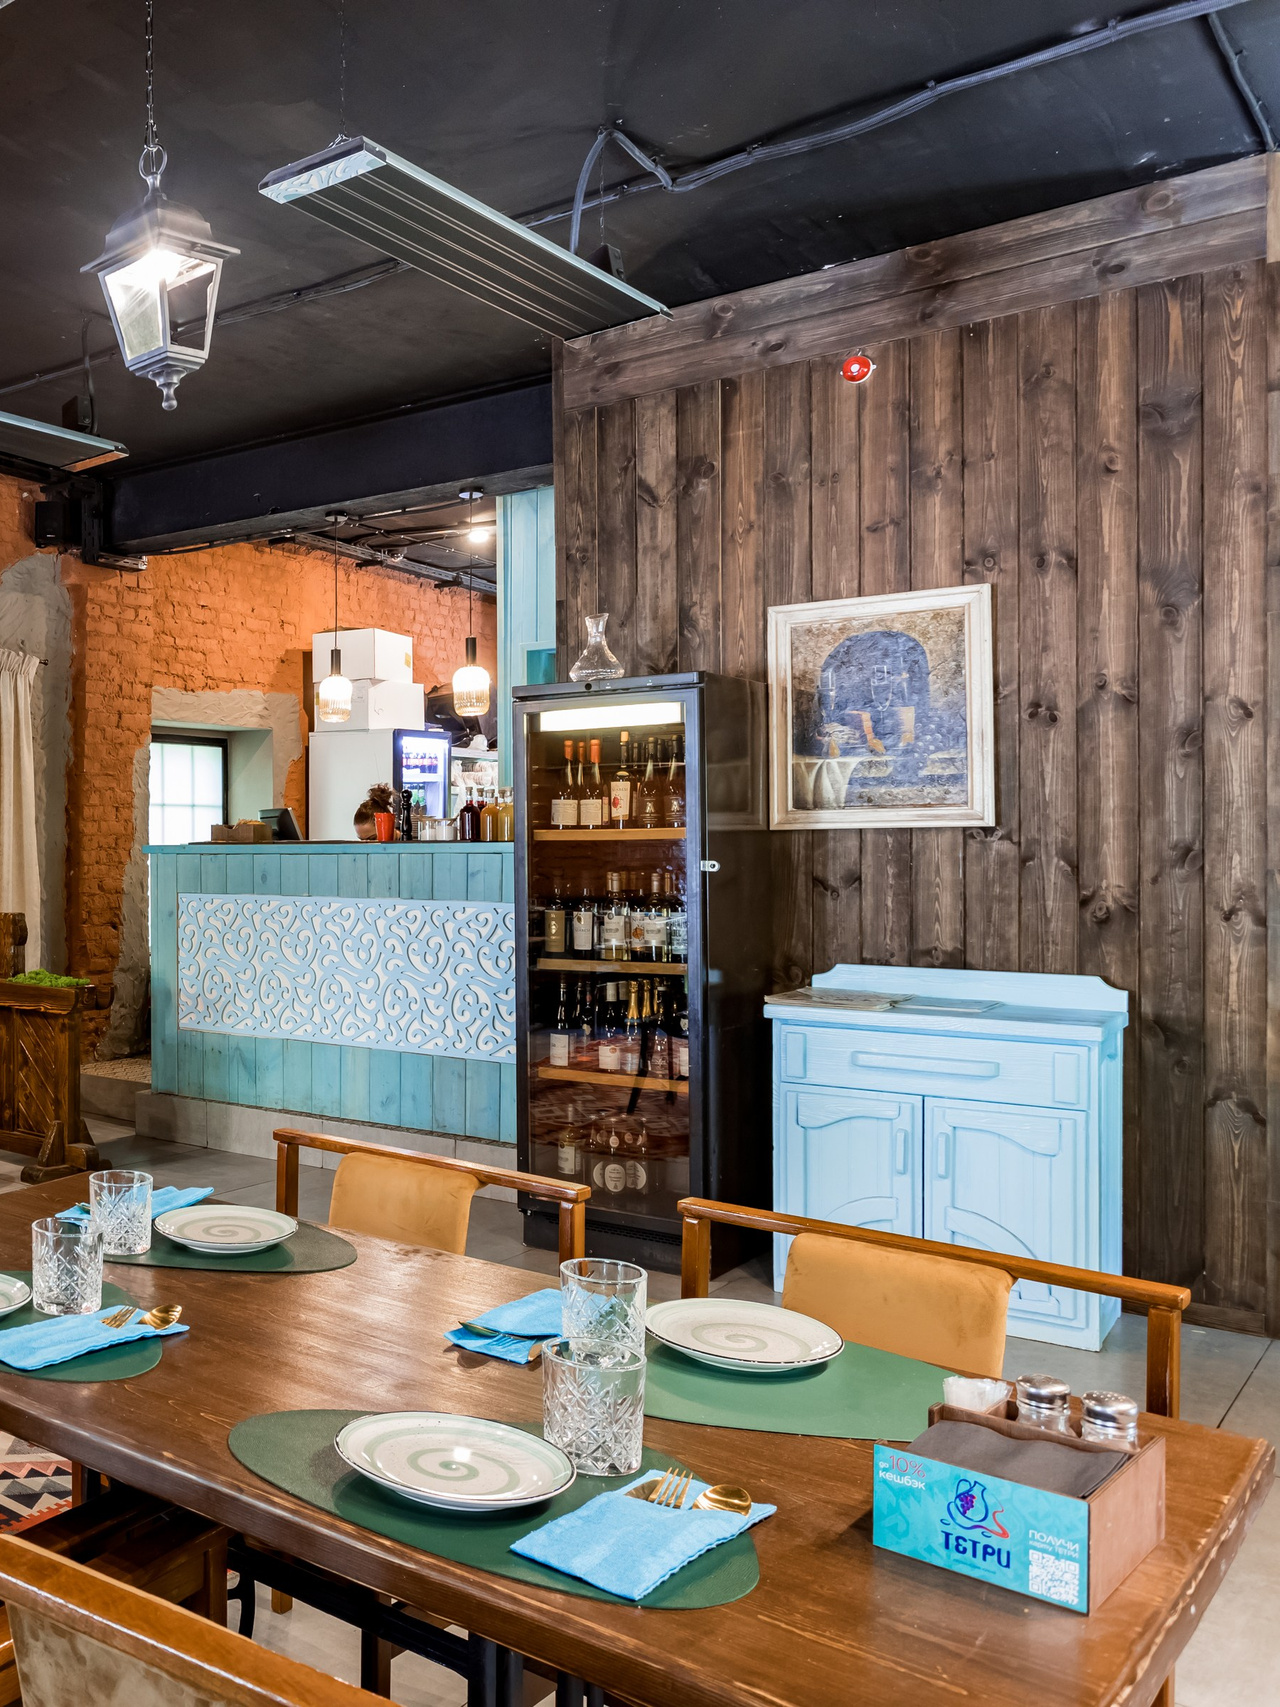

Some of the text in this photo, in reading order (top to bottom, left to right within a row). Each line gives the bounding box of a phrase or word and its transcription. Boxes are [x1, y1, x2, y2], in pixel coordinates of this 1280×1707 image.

[889, 1455, 926, 1479] 10%
[879, 1470, 926, 1491] кешбэк
[1029, 1529, 1080, 1552] ПОЛУЧИ
